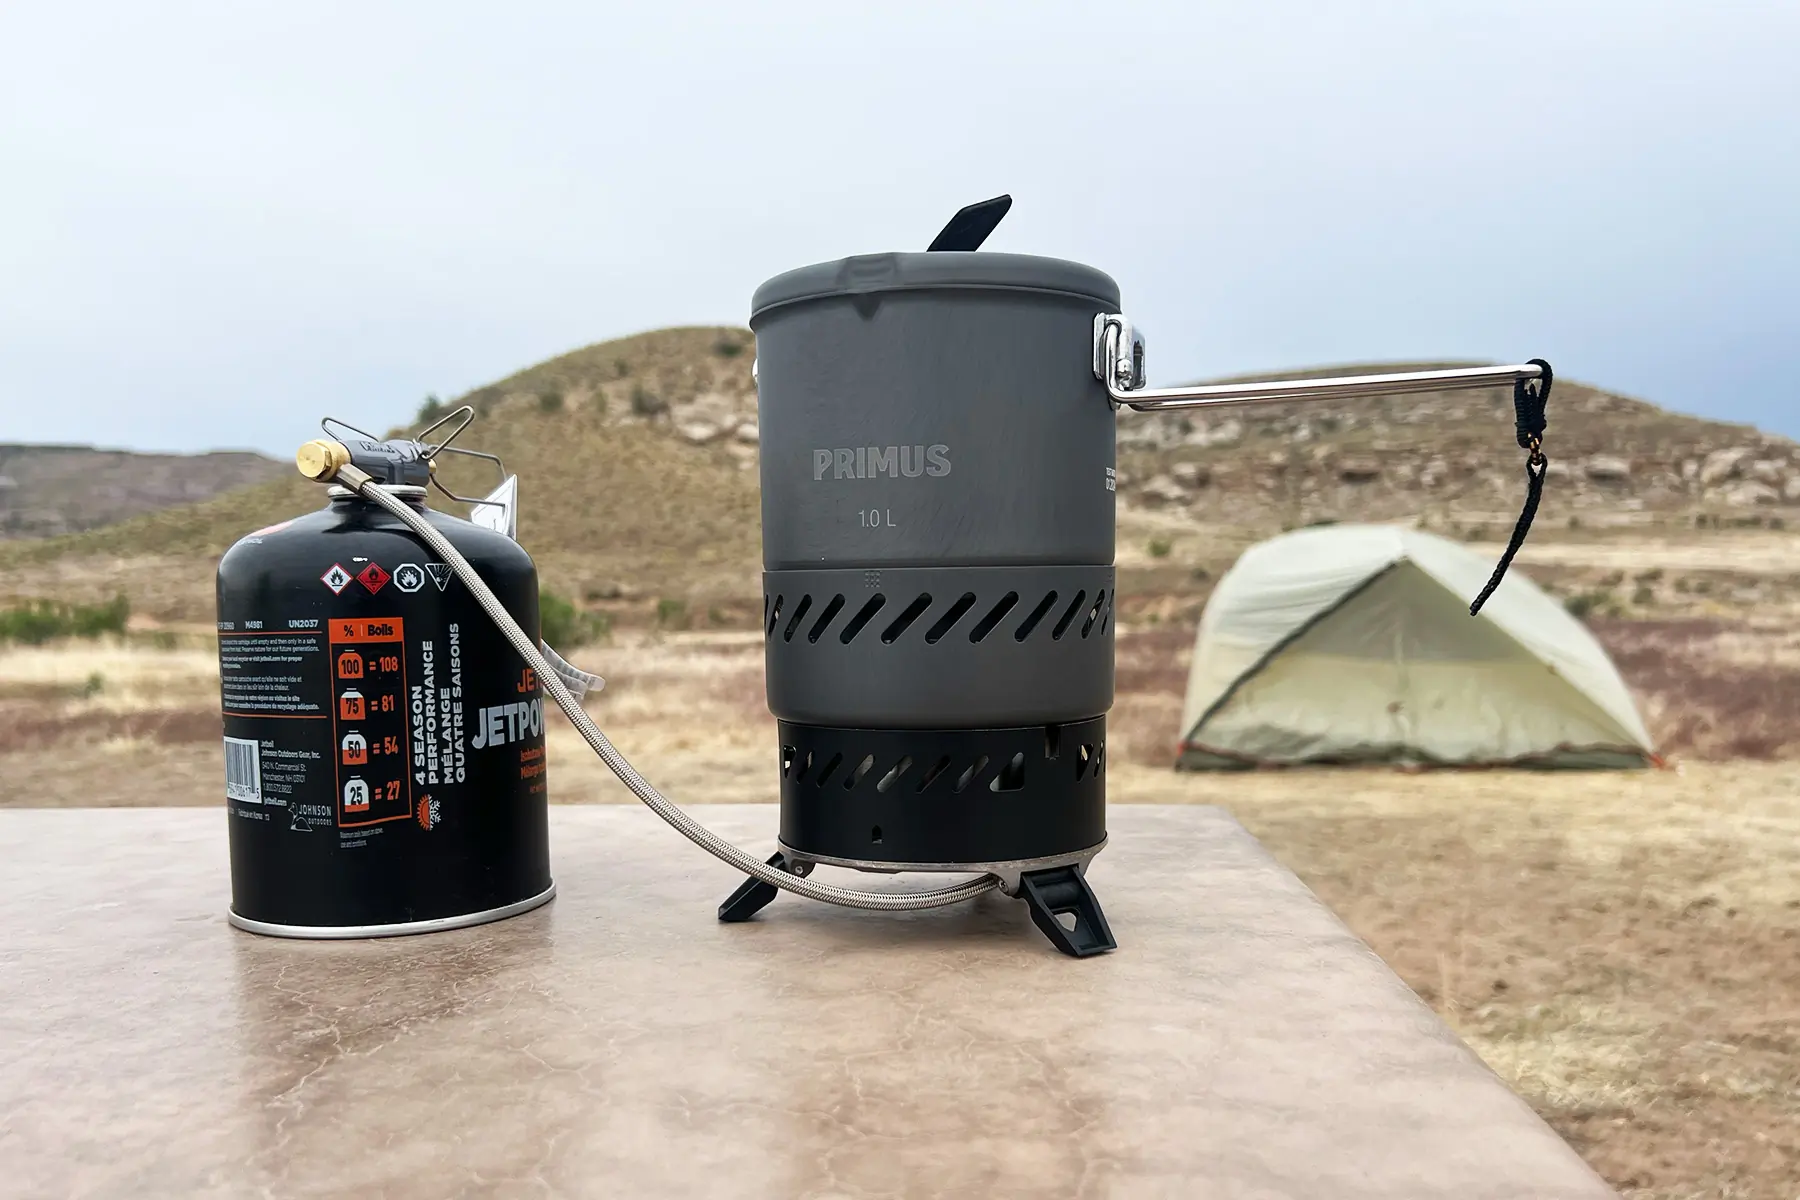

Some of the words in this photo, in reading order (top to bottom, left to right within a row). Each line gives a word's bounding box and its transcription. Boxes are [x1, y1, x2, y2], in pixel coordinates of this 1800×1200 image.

[813, 444, 951, 480] PRIMUS
[858, 509, 880, 527] 1.0
[886, 509, 896, 527] L
[288, 619, 319, 628] UN2037
[343, 624, 354, 637] %
[367, 623, 394, 636] Boils
[342, 659, 360, 675] 100
[369, 661, 376, 670] =
[380, 656, 398, 672] 108
[449, 623, 462, 698] SAISONS
[346, 698, 359, 714] 75
[371, 701, 378, 711] =
[382, 694, 395, 712] 81
[423, 640, 439, 784] PERFORMANCE
[411, 686, 425, 767] SEASON
[440, 687, 454, 784] MÉLANGE
[347, 741, 361, 759] 50
[373, 743, 380, 754] =
[384, 736, 398, 755] 54
[453, 701, 466, 783] QUATRE
[278, 750, 298, 758] Outdoors
[415, 771, 426, 786] 4
[350, 786, 363, 805] 25
[375, 788, 382, 800] =
[387, 780, 400, 800] 27
[299, 804, 332, 816] JOHNSON
[308, 818, 332, 826] OUTDOORS
